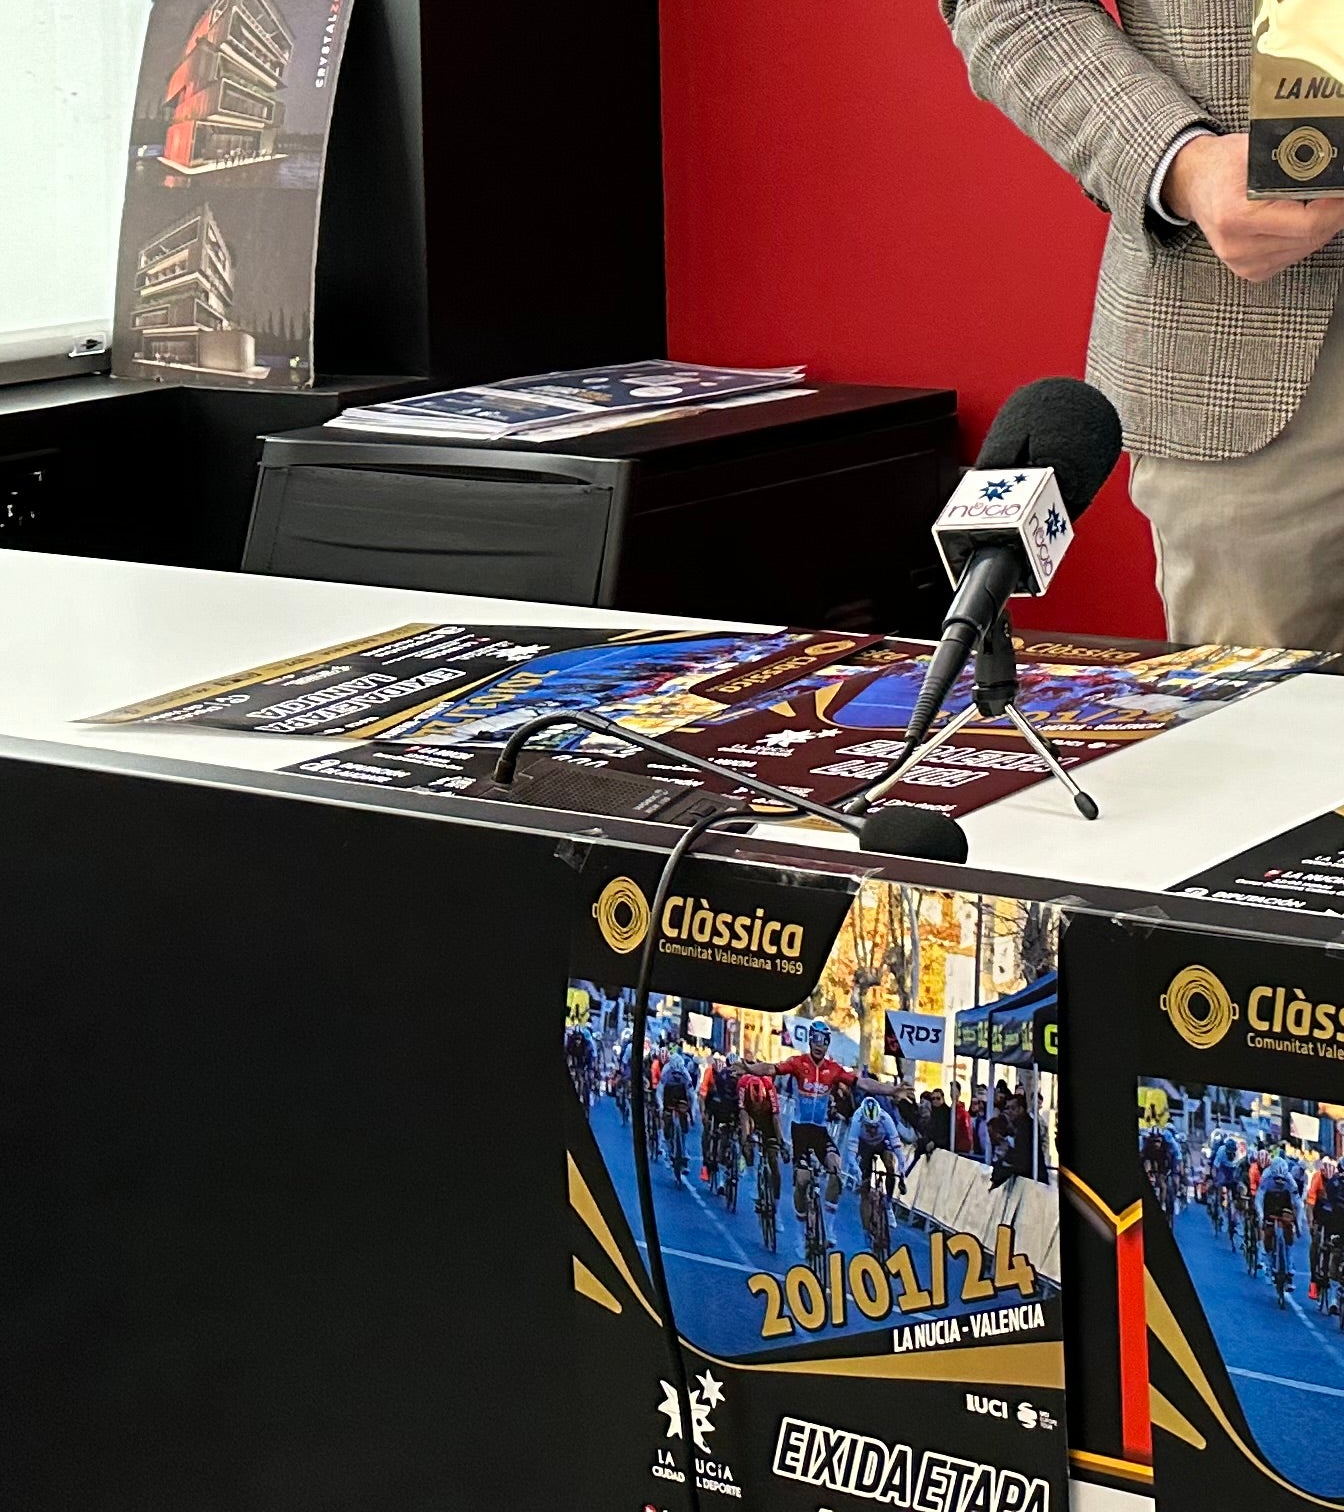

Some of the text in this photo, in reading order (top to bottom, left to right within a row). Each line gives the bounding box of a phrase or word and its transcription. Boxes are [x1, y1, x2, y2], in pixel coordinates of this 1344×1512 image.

[1274, 78, 1302, 100] LA
[661, 895, 804, 958] Clàssica
[659, 938, 804, 976] Comunitat Valenciana 1969
[900, 1023, 942, 1047] RD3
[1246, 1032, 1315, 1056] Comunitat
[747, 1224, 1036, 1338] 20/01/24
[893, 1303, 1046, 1353] LA NUCIA VALENCIA
[657, 1448, 675, 1468] LA
[772, 1415, 913, 1508] EIXIDA
[651, 1464, 742, 1499] CIUDAD DEPORTE
